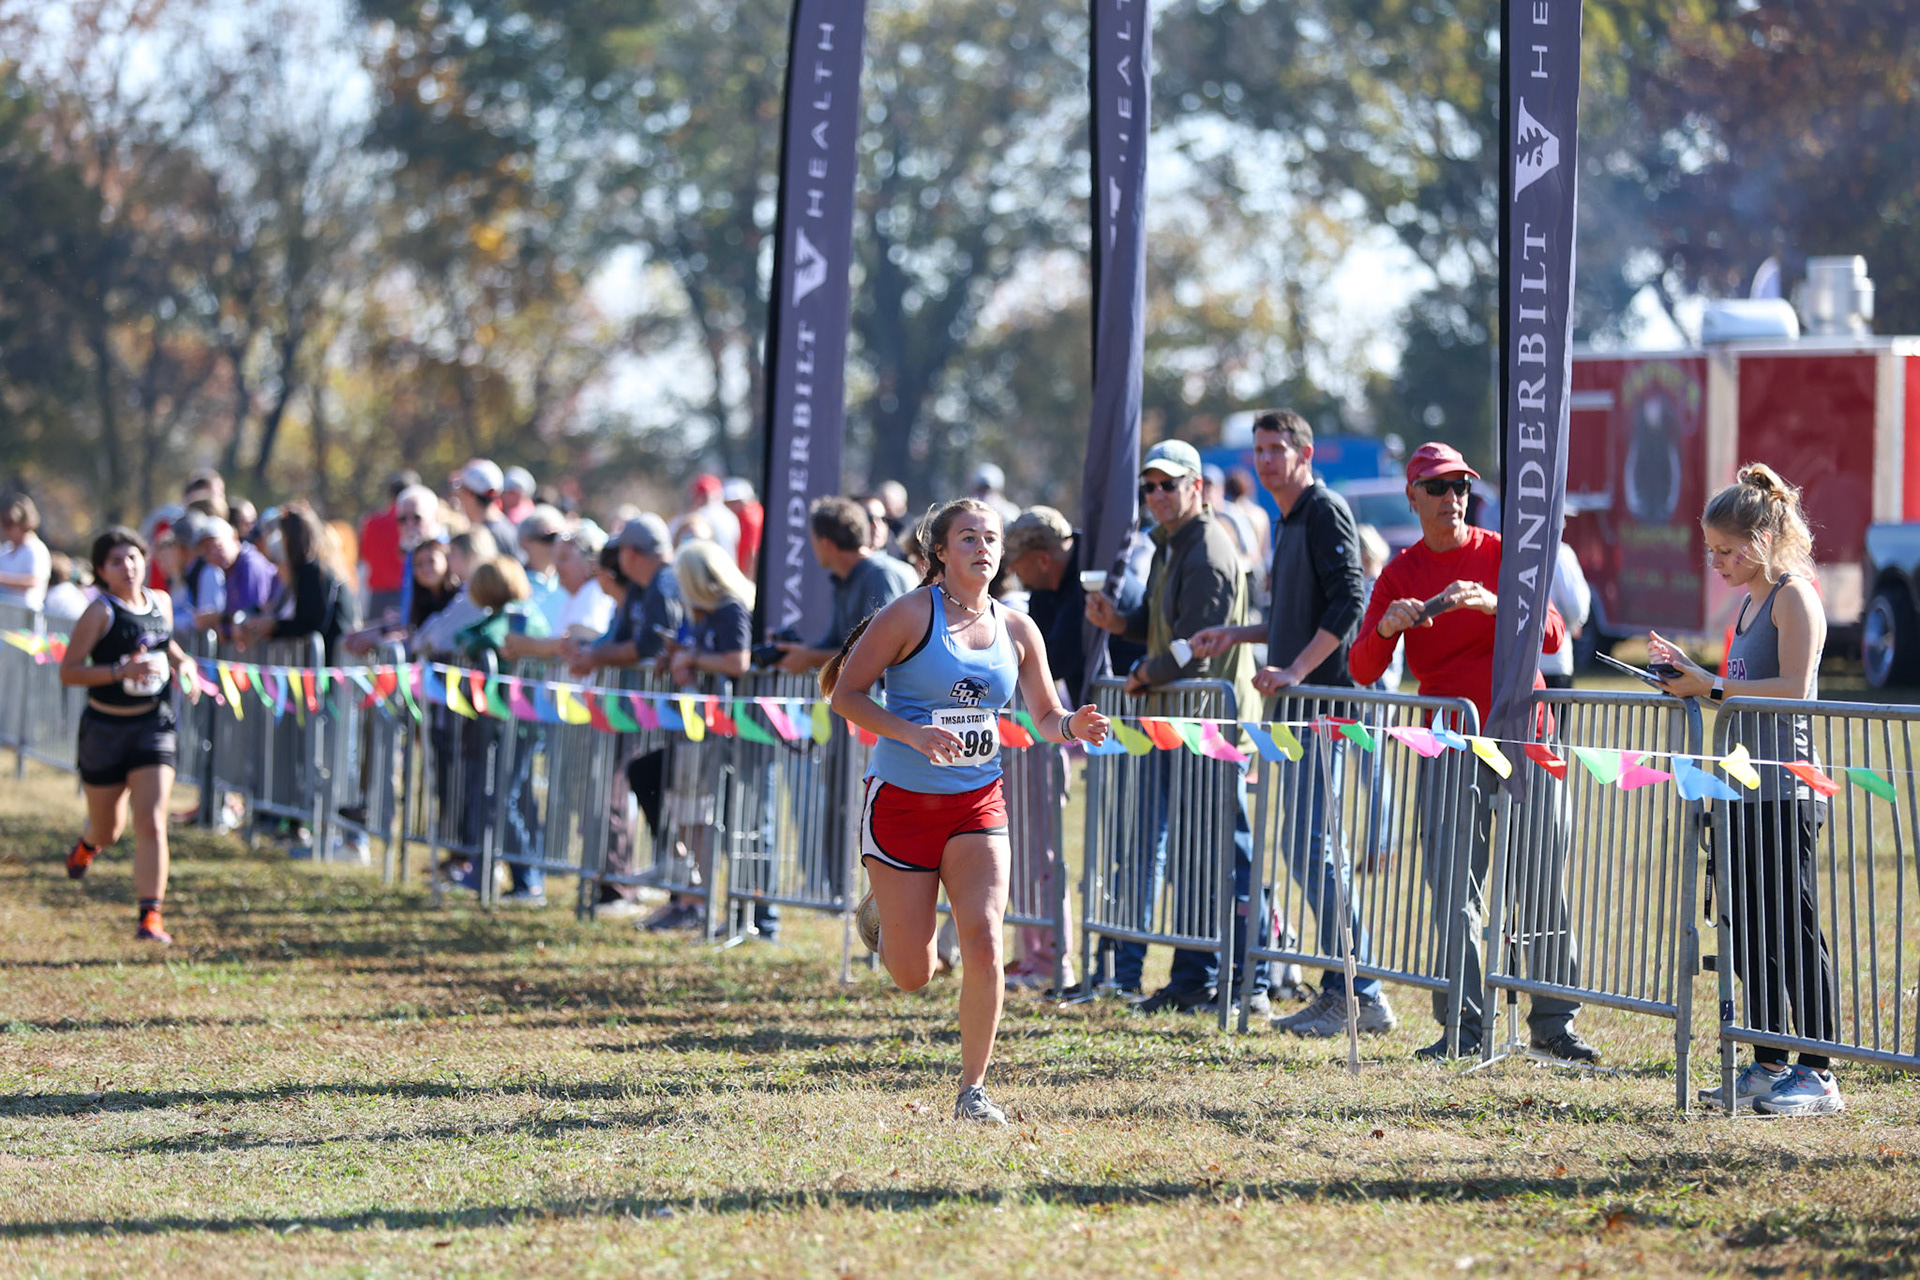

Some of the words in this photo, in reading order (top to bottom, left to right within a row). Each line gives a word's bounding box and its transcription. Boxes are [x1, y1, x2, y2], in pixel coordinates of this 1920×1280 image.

[1116, 0, 1131, 162] EAL
[782, 320, 816, 627] VANDERBILT
[806, 22, 835, 218] HEALTH
[1516, 222, 1547, 637] VANDERBILT
[941, 715, 966, 725] TMSAA
[967, 714, 986, 724] STATE
[957, 729, 994, 758] 98
